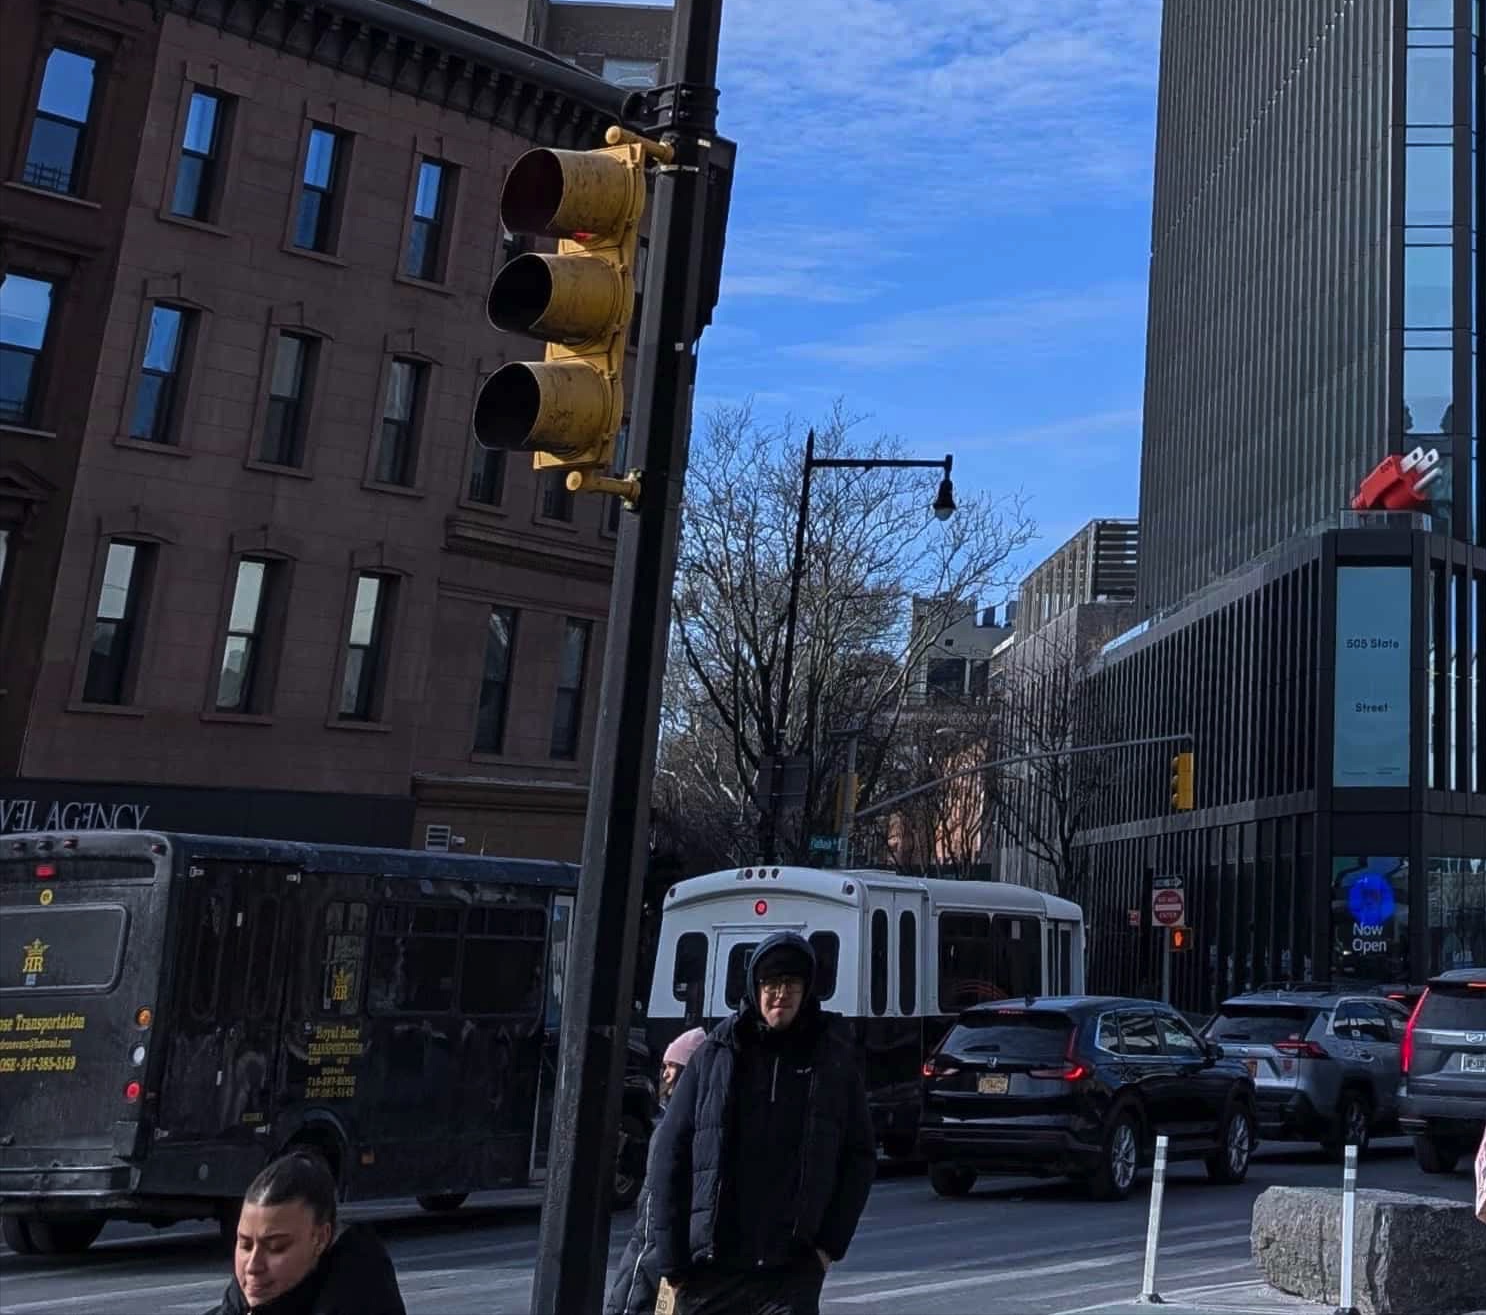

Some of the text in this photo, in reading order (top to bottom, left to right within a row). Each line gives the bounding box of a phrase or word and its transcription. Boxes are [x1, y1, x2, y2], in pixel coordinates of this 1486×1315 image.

[1370, 638, 1400, 649] State
[1355, 702, 1389, 713] Street
[1352, 922, 1384, 936] Now
[1352, 938, 1387, 956] Open
[15, 1012, 85, 1035] Transportation
